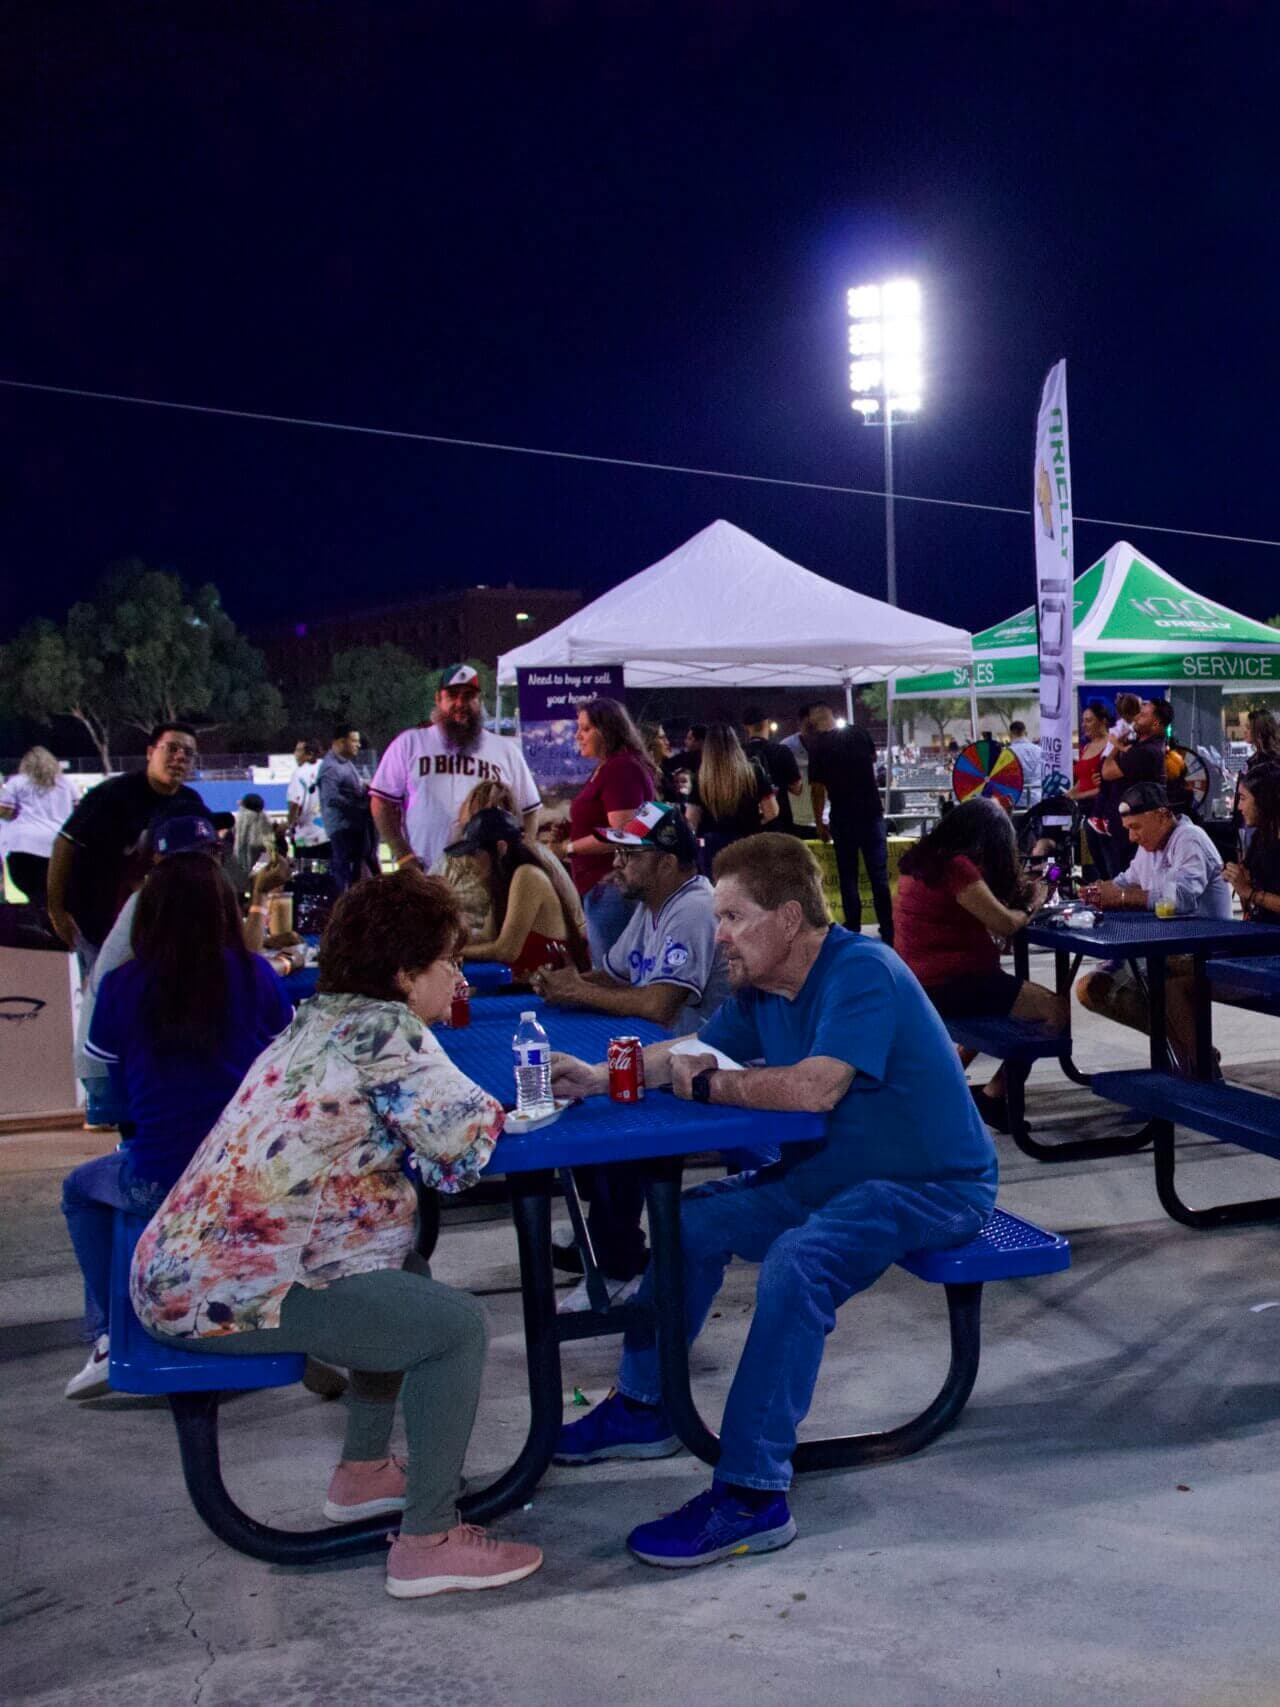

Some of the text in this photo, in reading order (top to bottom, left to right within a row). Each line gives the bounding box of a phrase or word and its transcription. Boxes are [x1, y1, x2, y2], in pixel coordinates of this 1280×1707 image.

[953, 663, 994, 685] SAES
[1182, 656, 1273, 676] SERVICE
[528, 673, 552, 685] Need
[554, 674, 563, 685] to
[565, 673, 580, 688] buy
[583, 676, 592, 685] or
[546, 695, 567, 708] your
